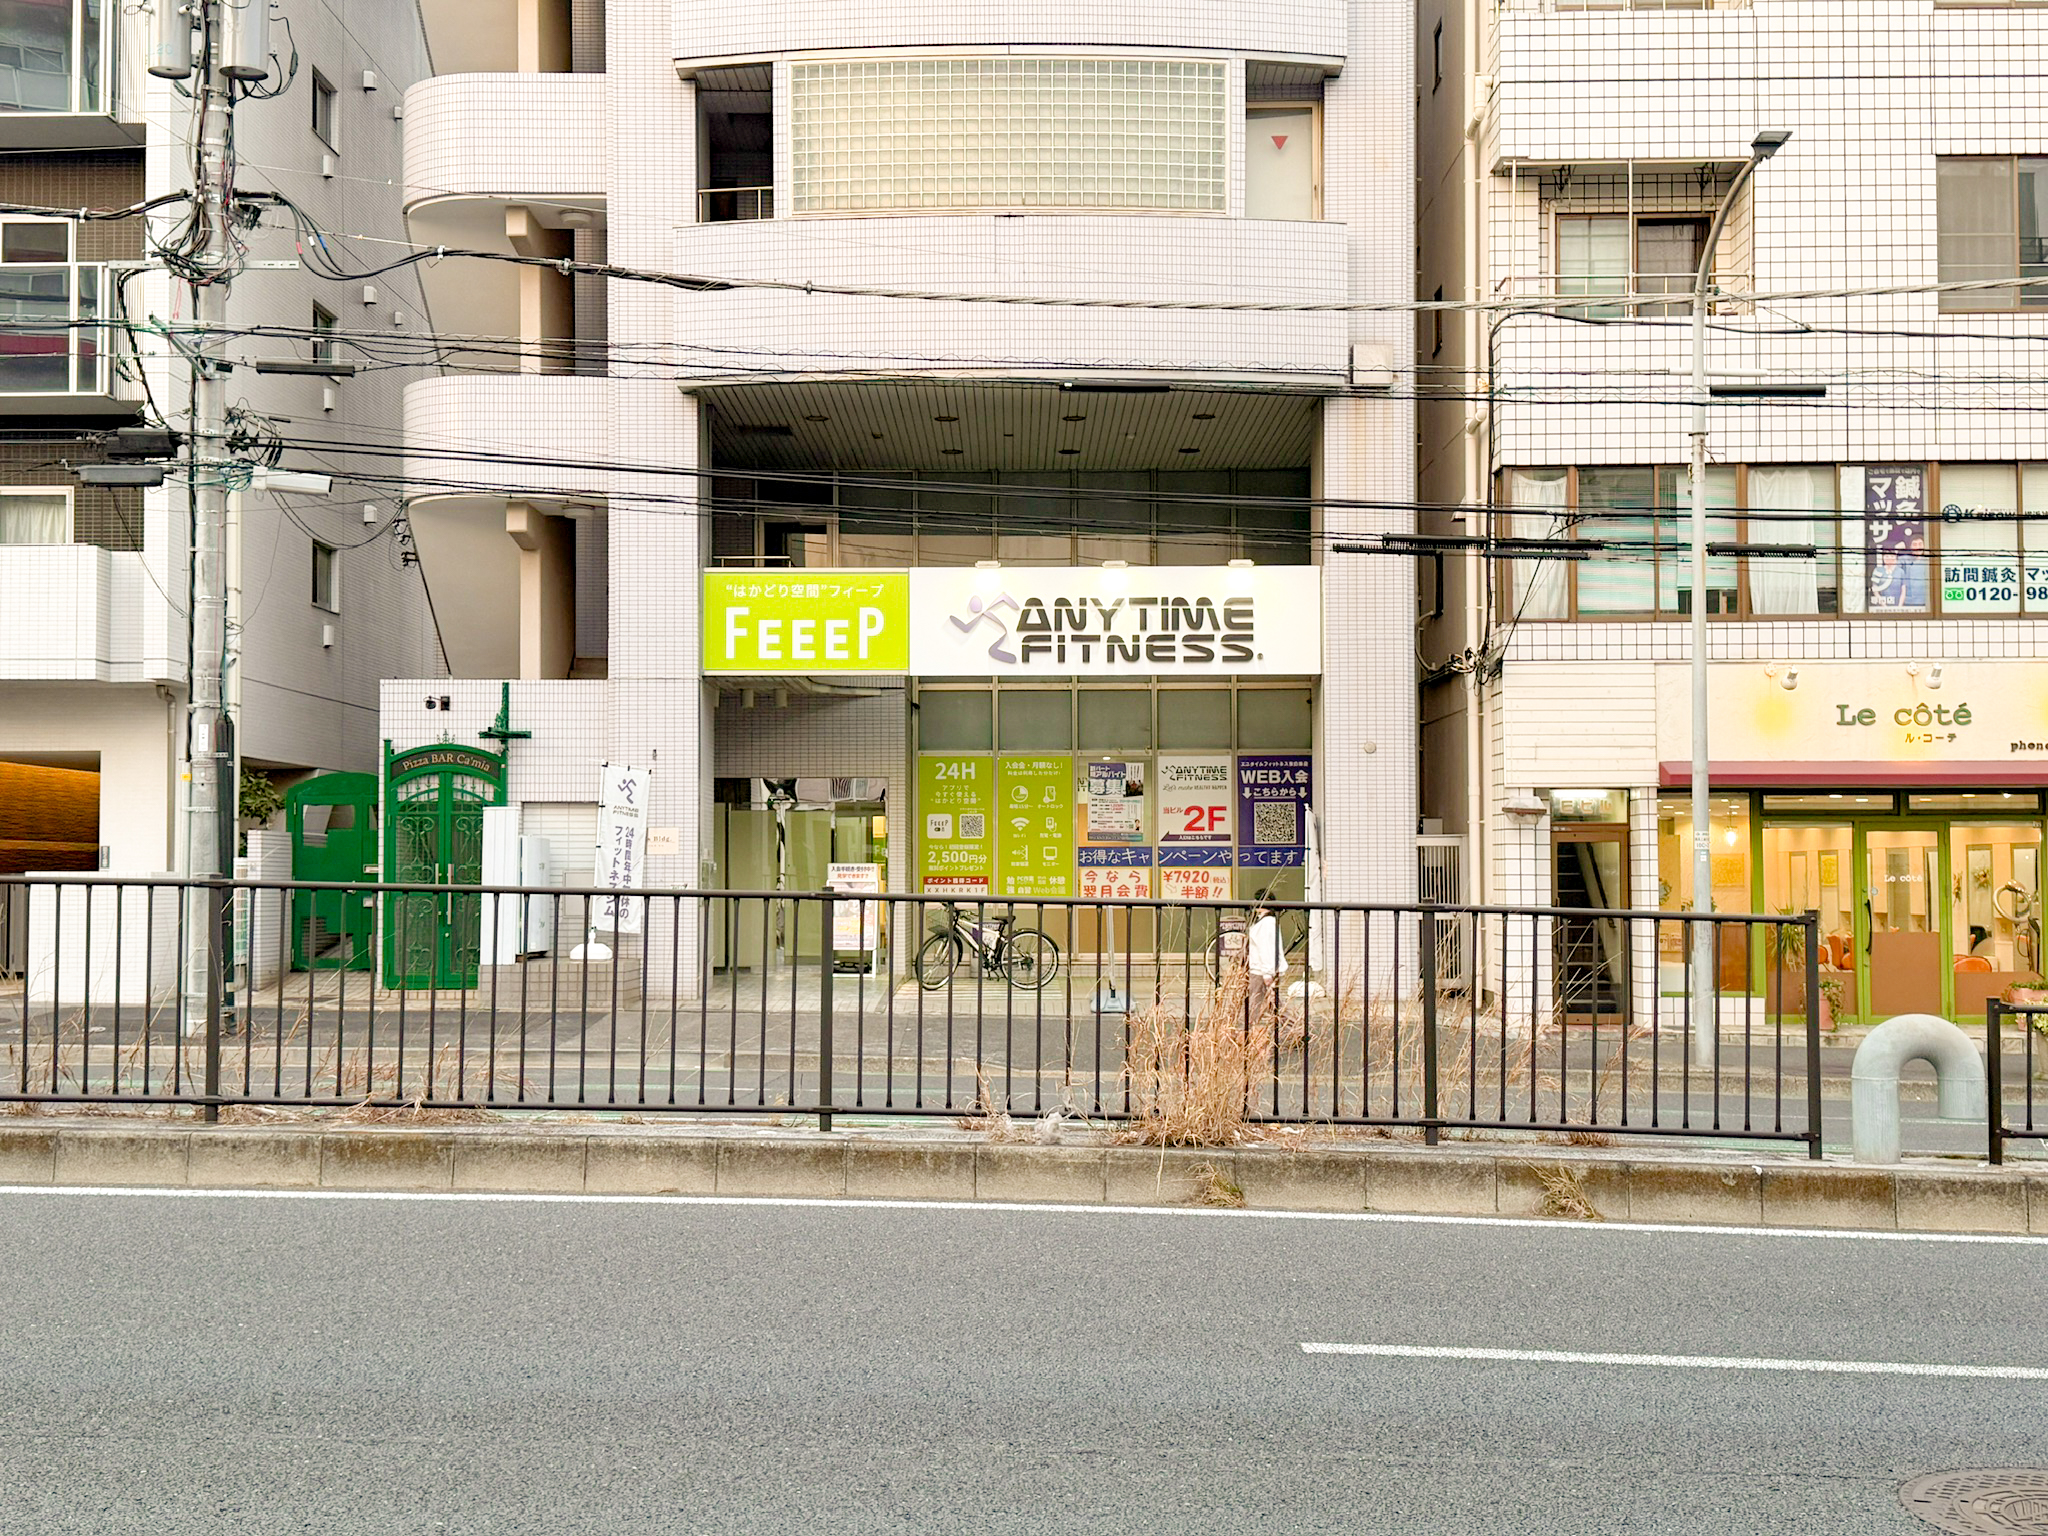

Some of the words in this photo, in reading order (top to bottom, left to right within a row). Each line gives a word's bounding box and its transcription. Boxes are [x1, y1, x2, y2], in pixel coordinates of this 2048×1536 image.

[1944, 567, 2017, 582] 訪問鍼灸
[1016, 597, 1254, 632] ANYTIME
[725, 606, 885, 660] FEEEP
[1021, 634, 1254, 663] FITNESS
[1836, 704, 1876, 726] Le
[1894, 702, 1972, 726] côté
[1904, 733, 1957, 744] ル・コーテ
[402, 756, 429, 771] Pizza
[431, 752, 454, 763] BAR
[456, 754, 490, 772] Ca'mia
[1175, 765, 1227, 774] ANYTIME
[935, 762, 976, 780] 24H
[1240, 769, 1309, 784] WEB入会
[1253, 787, 1297, 797] こちらから
[613, 805, 639, 813] ANYTIME
[613, 810, 639, 818] FITNESS
[1183, 805, 1227, 831] 2F
[928, 851, 988, 865] 2,500円分
[620, 826, 634, 919] 24時間年中休の
[1084, 870, 1142, 884] 今なら
[1884, 874, 1896, 883] Le
[1083, 884, 1149, 898] 翌月会費
